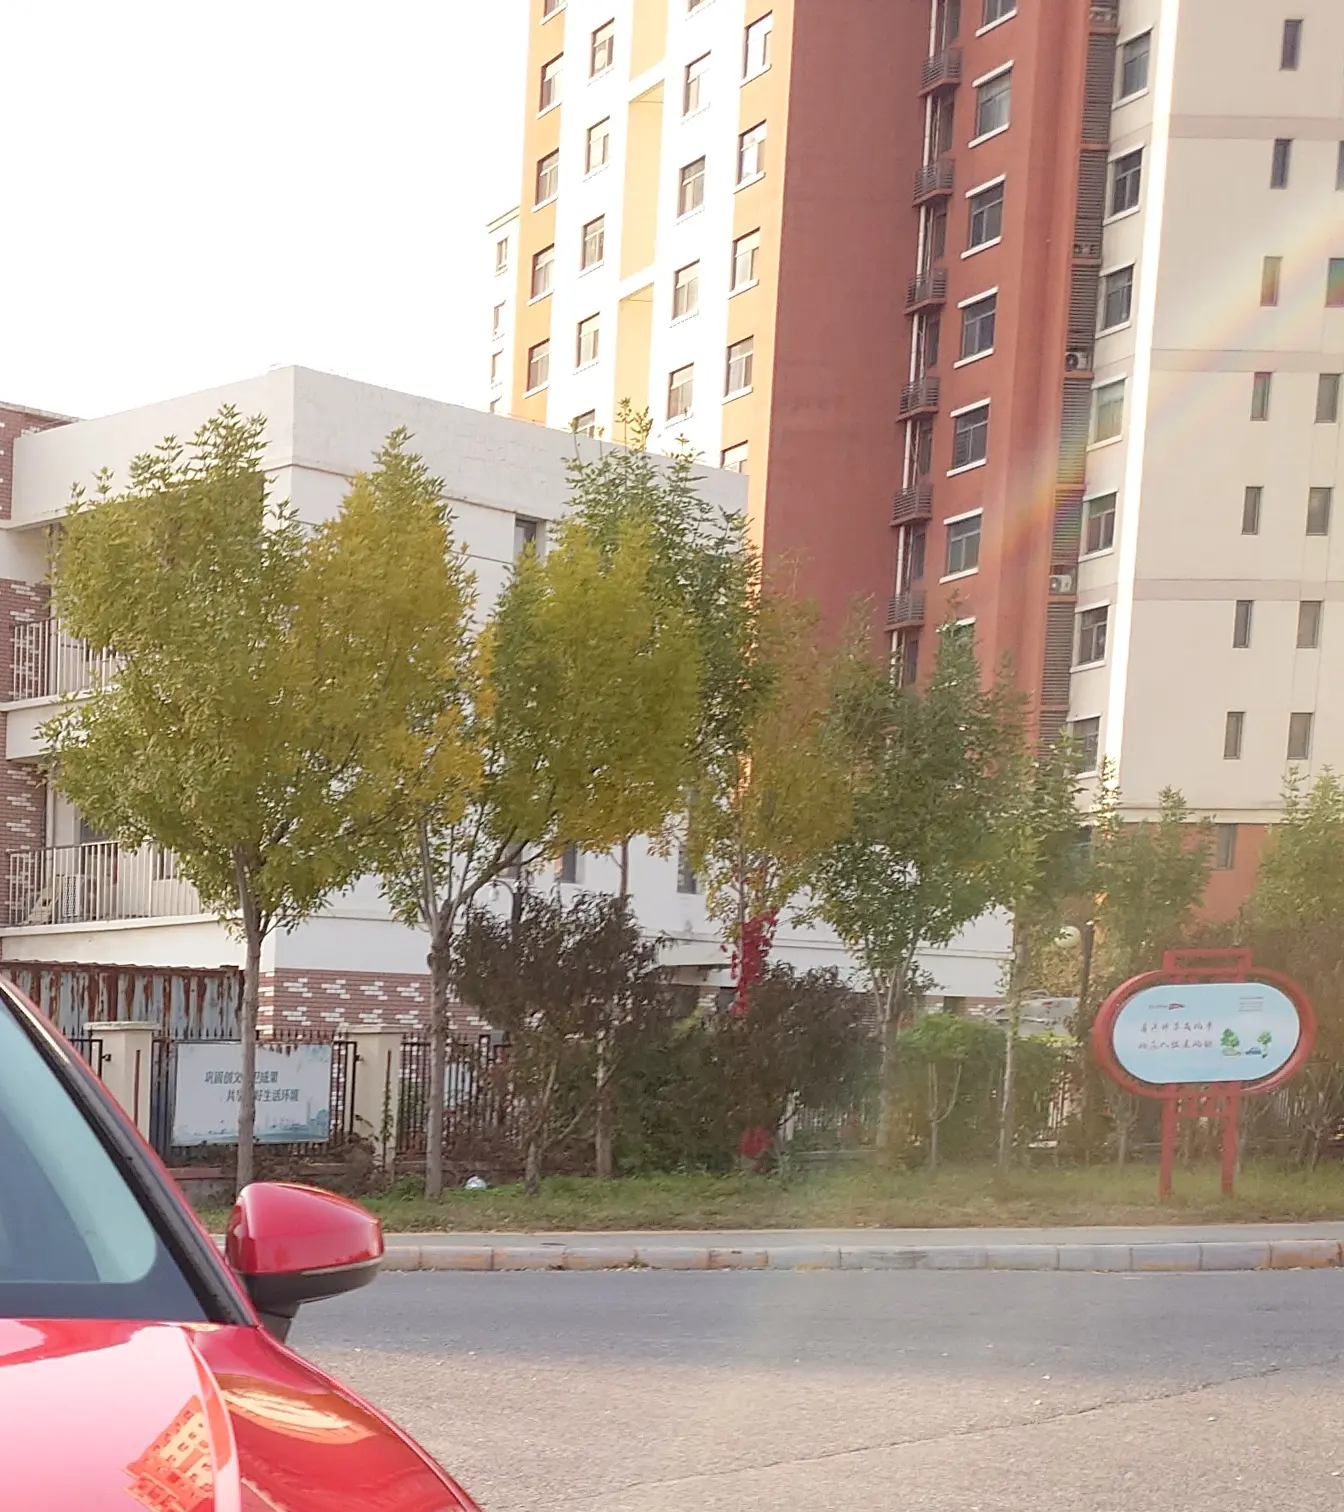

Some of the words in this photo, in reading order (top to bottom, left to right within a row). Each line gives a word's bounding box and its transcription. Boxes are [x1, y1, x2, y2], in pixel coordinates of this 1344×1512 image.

[204, 1070, 278, 1084] 巩固创文卫成果
[225, 1088, 300, 1102] 共好生活环境
